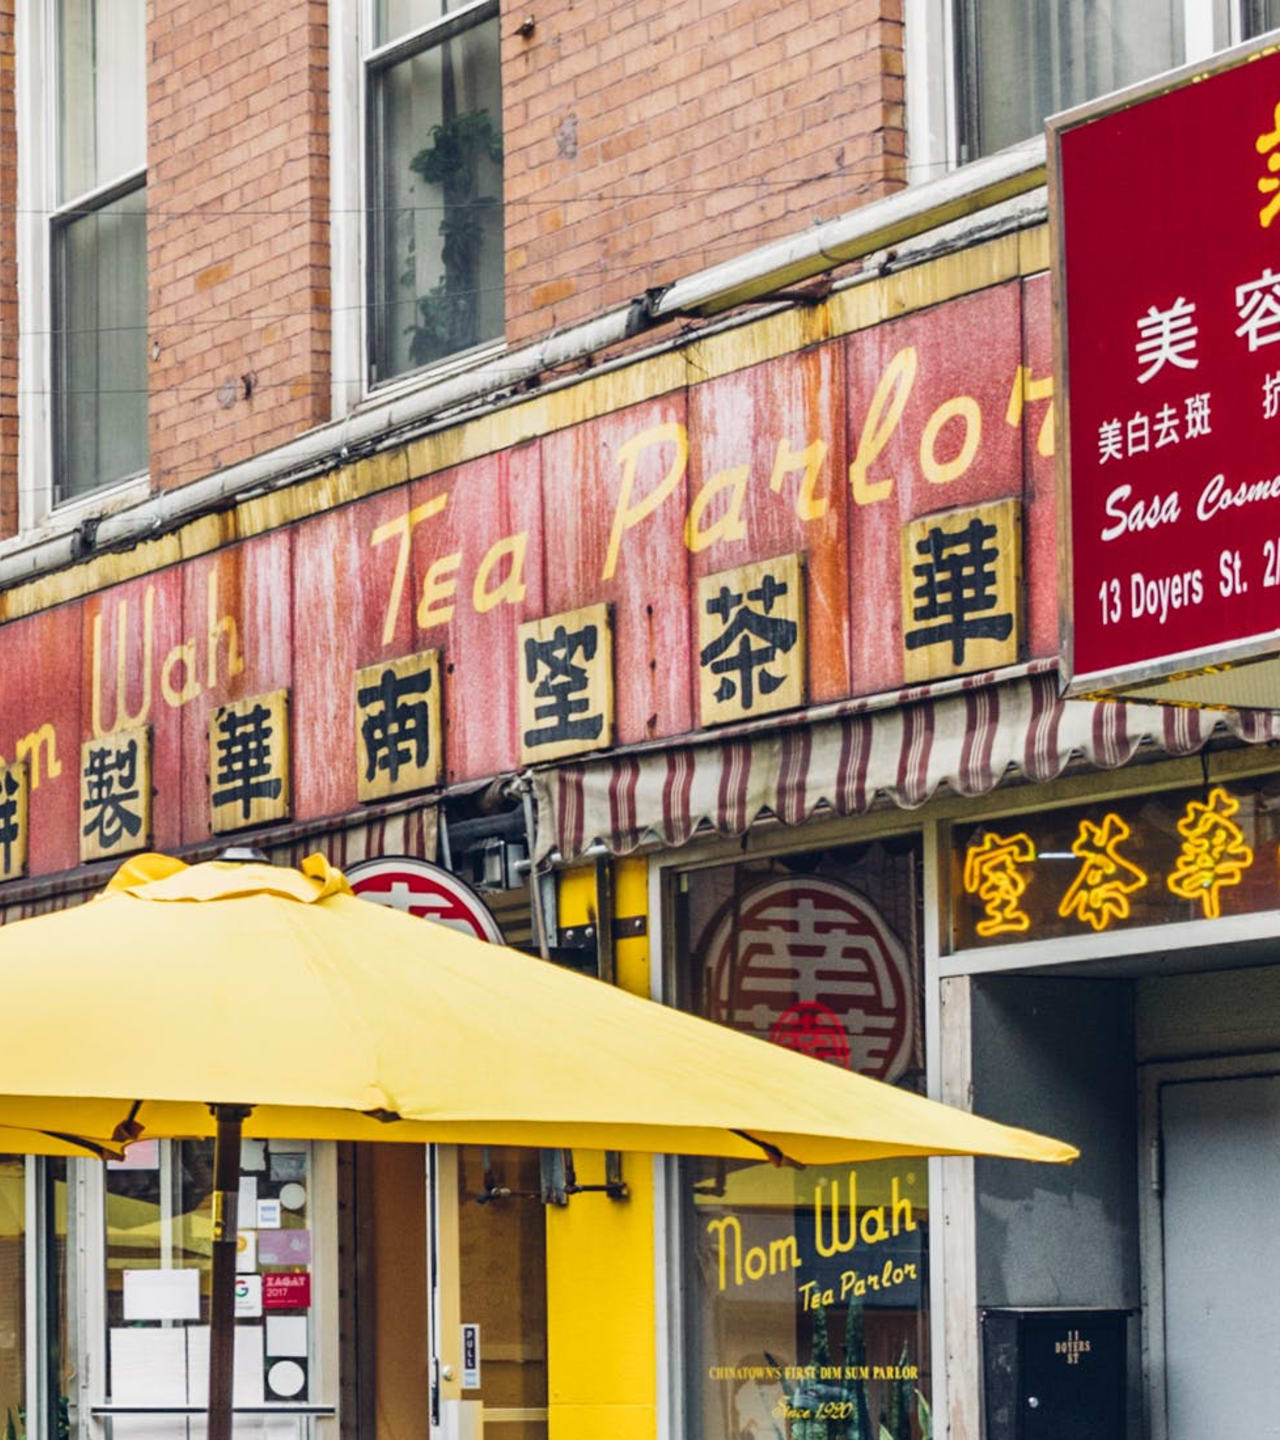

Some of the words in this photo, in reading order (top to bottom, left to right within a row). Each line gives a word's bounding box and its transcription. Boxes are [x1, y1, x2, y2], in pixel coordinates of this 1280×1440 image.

[1098, 393, 1212, 464] 美白去斑
[1101, 484, 1181, 542] Sasa
[92, 568, 244, 733] Wah
[371, 492, 529, 647] Tea
[1099, 578, 1122, 625] 13
[1131, 569, 1204, 625] Doyers
[1219, 550, 1248, 598] St.
[707, 1216, 803, 1292] Nom
[815, 1170, 917, 1258] Wah
[266, 1276, 306, 1287] ZAGAT
[267, 1287, 288, 1297] 2017
[799, 1279, 835, 1313] Tea
[840, 1260, 918, 1301] Parlor
[820, 1366, 841, 1380] DIM
[844, 1366, 870, 1380] SUM
[873, 1366, 919, 1380] PARLOR
[1055, 1340, 1091, 1353] DOYERS
[1067, 1353, 1079, 1364] ST
